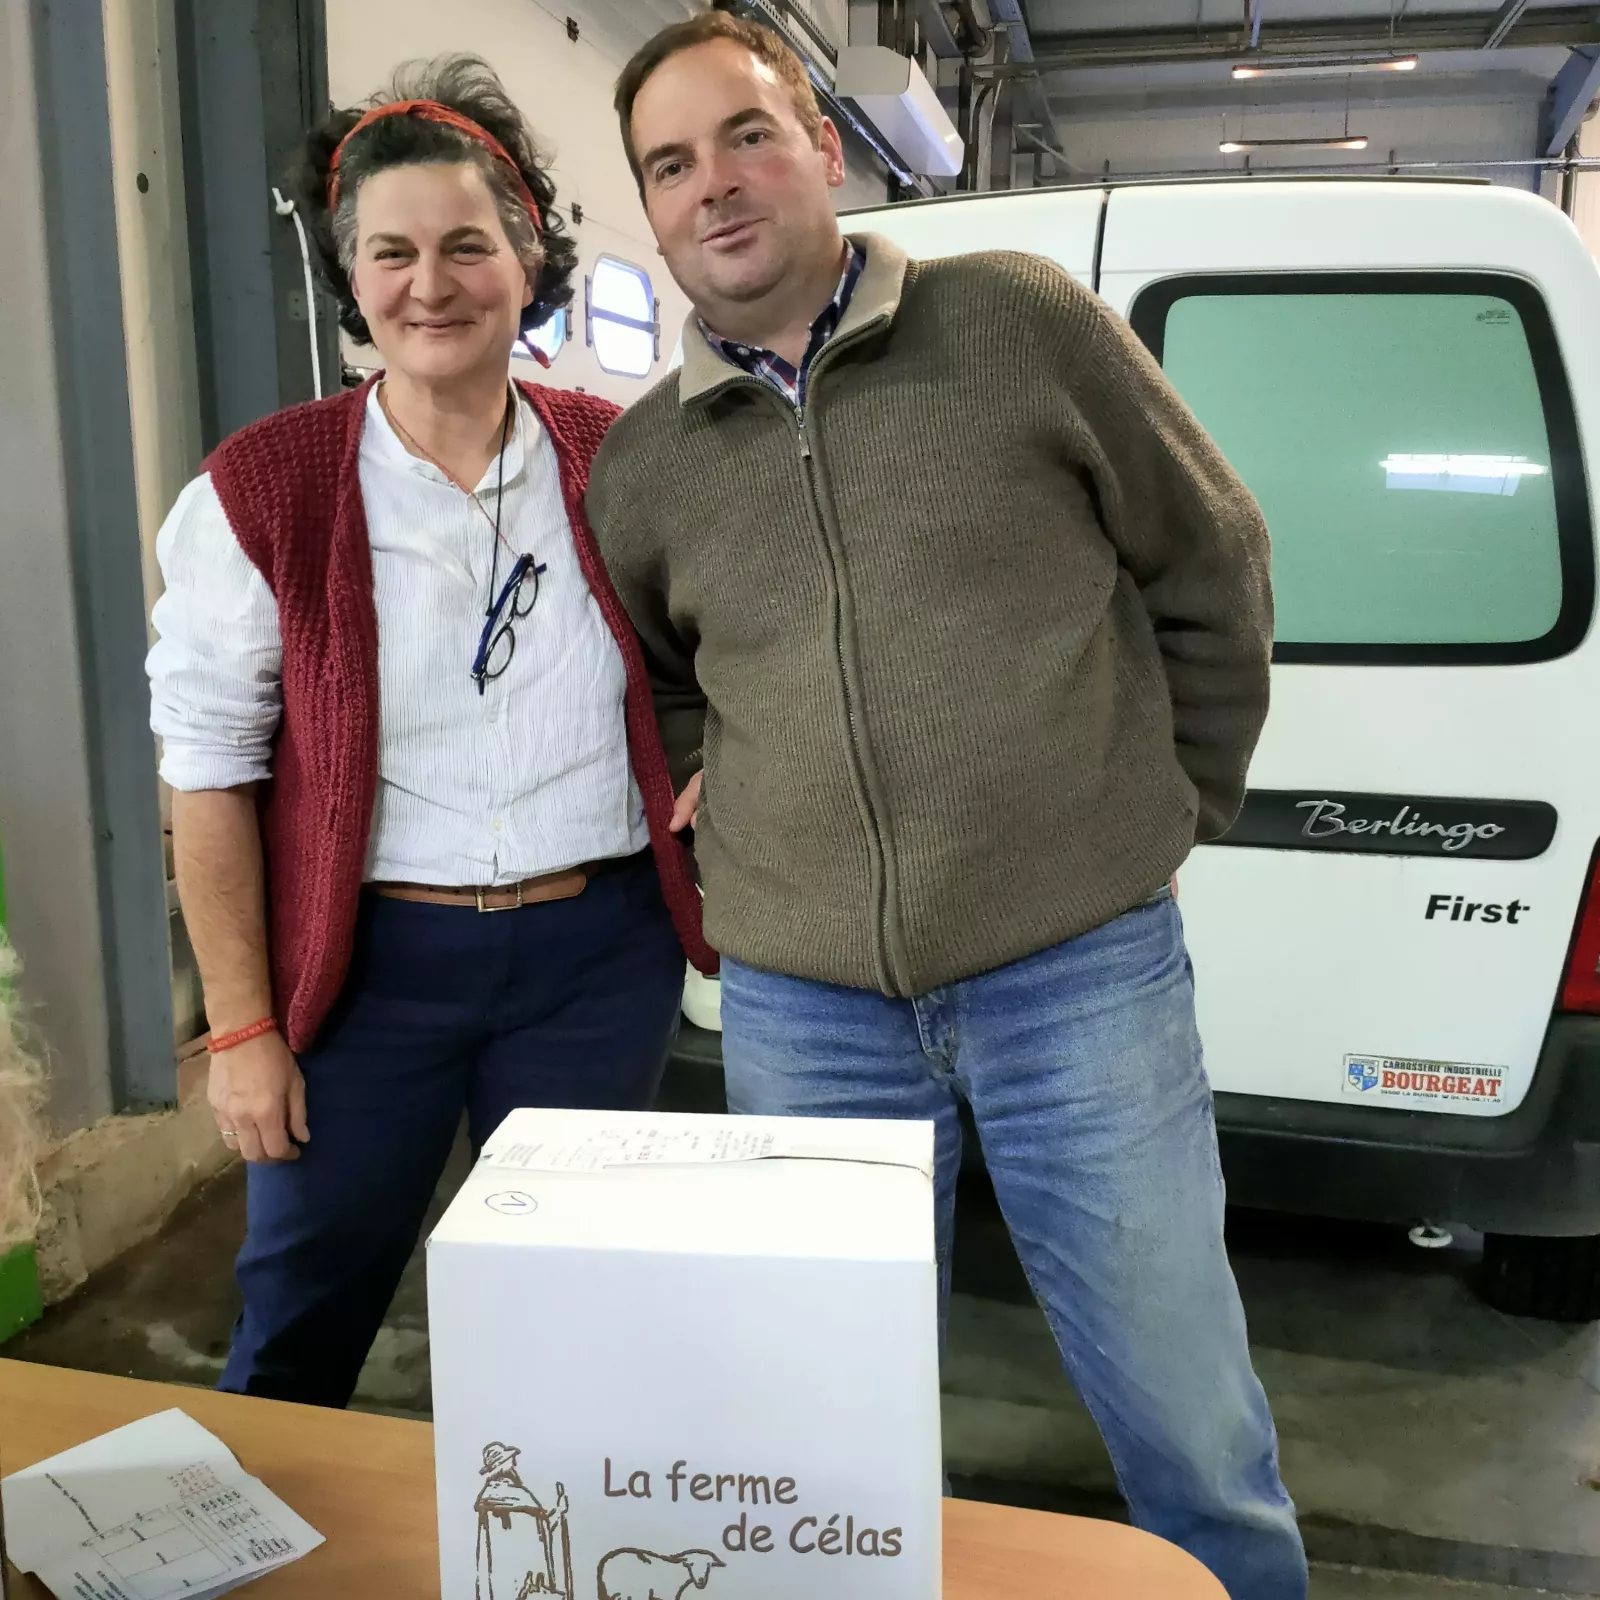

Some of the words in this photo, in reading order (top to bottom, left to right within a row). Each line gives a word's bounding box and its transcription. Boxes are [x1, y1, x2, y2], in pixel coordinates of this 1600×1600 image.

[1295, 799, 1506, 851] Berlingo
[1425, 893, 1521, 925] First
[1381, 1070, 1502, 1097] BOURGEAT
[1382, 1060, 1441, 1074] CARROSSERIE
[1443, 1066, 1503, 1078] INDUSTRIELLE
[604, 1457, 652, 1499] La
[665, 1459, 799, 1506] ferme
[722, 1511, 775, 1553] de
[788, 1513, 904, 1557] Célas
